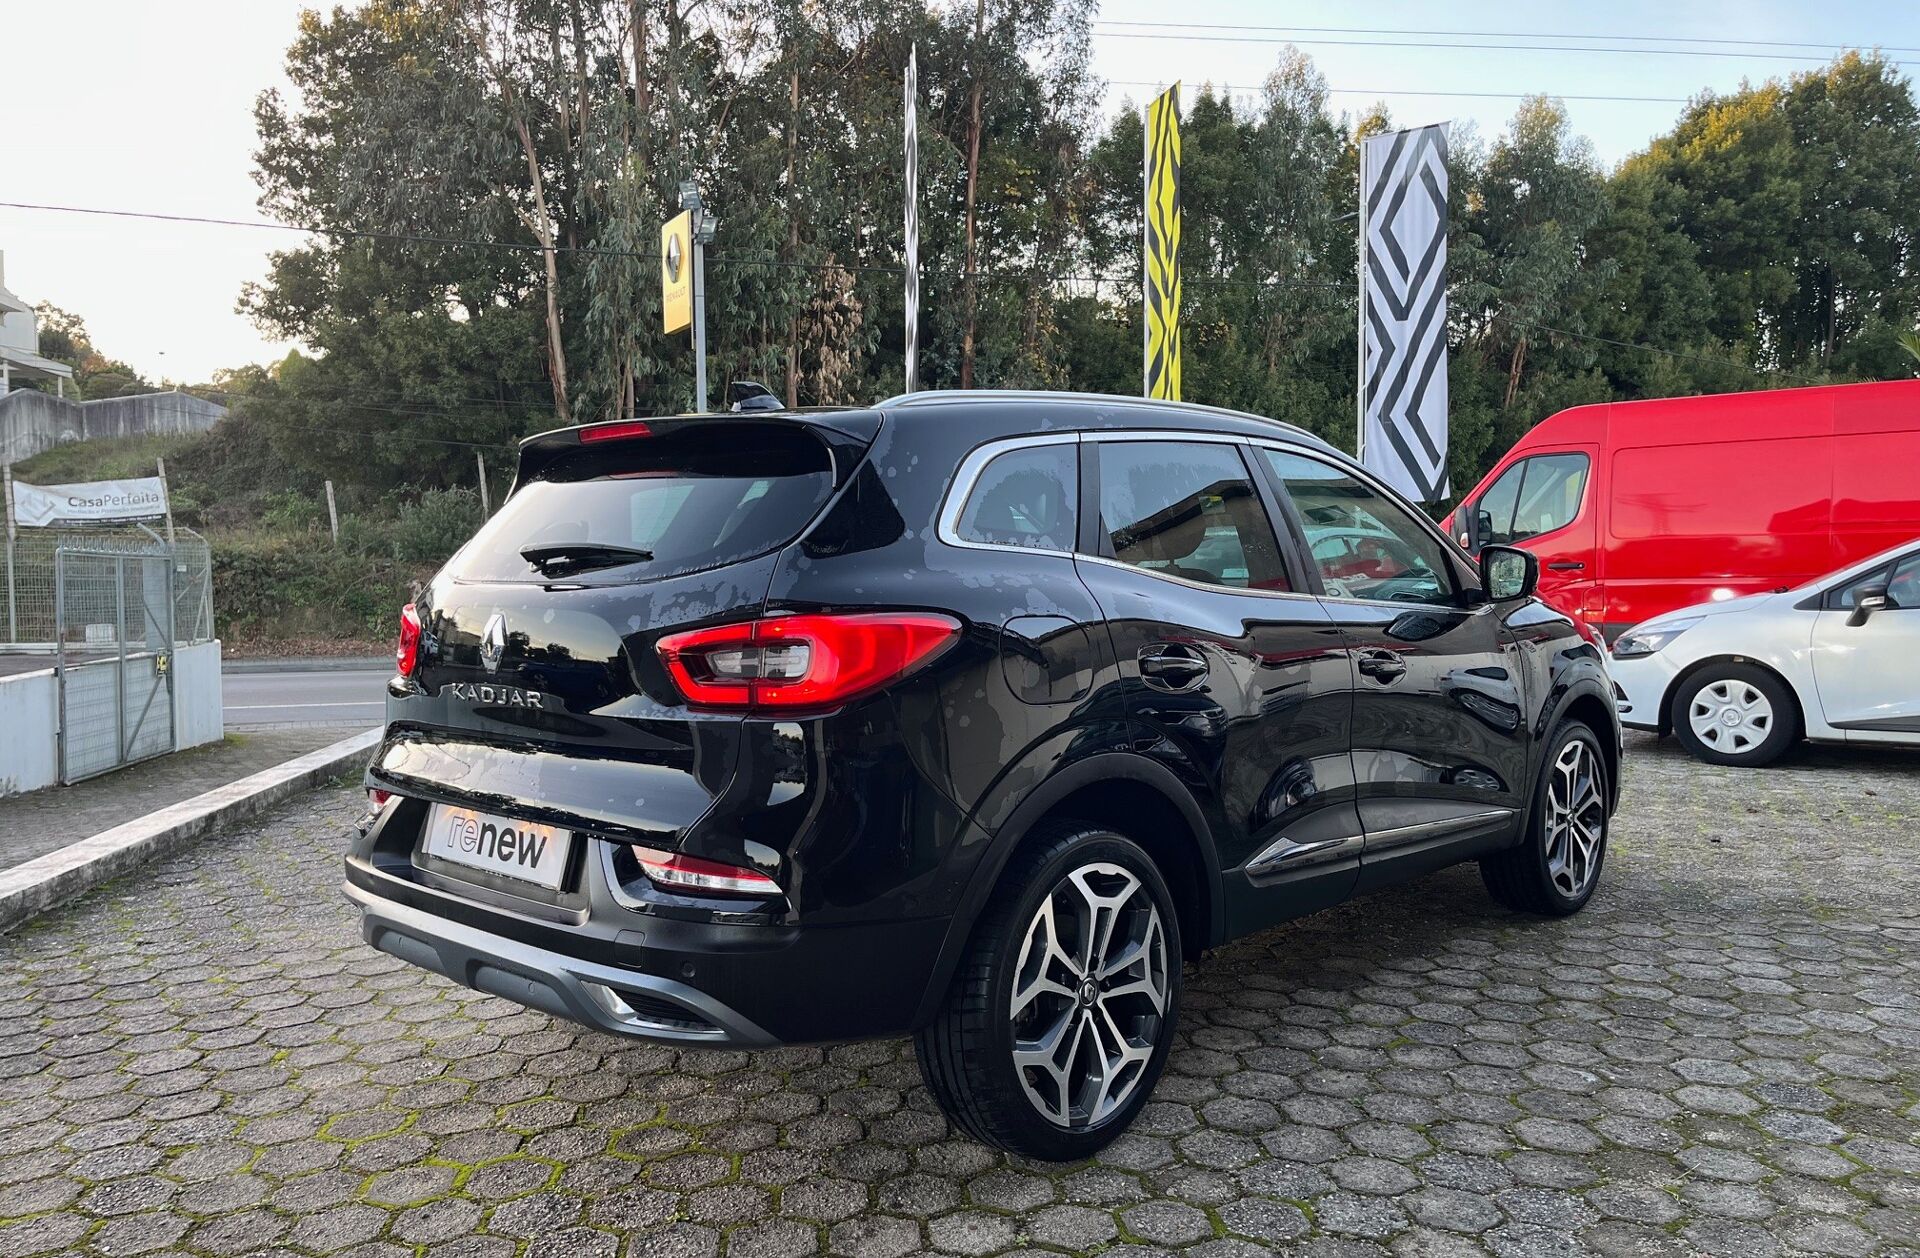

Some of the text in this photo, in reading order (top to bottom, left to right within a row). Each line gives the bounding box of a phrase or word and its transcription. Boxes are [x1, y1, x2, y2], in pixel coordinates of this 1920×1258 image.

[68, 492, 159, 507] CasaPerfeita
[451, 682, 544, 709] KADJAR
[447, 816, 548, 869] renew
